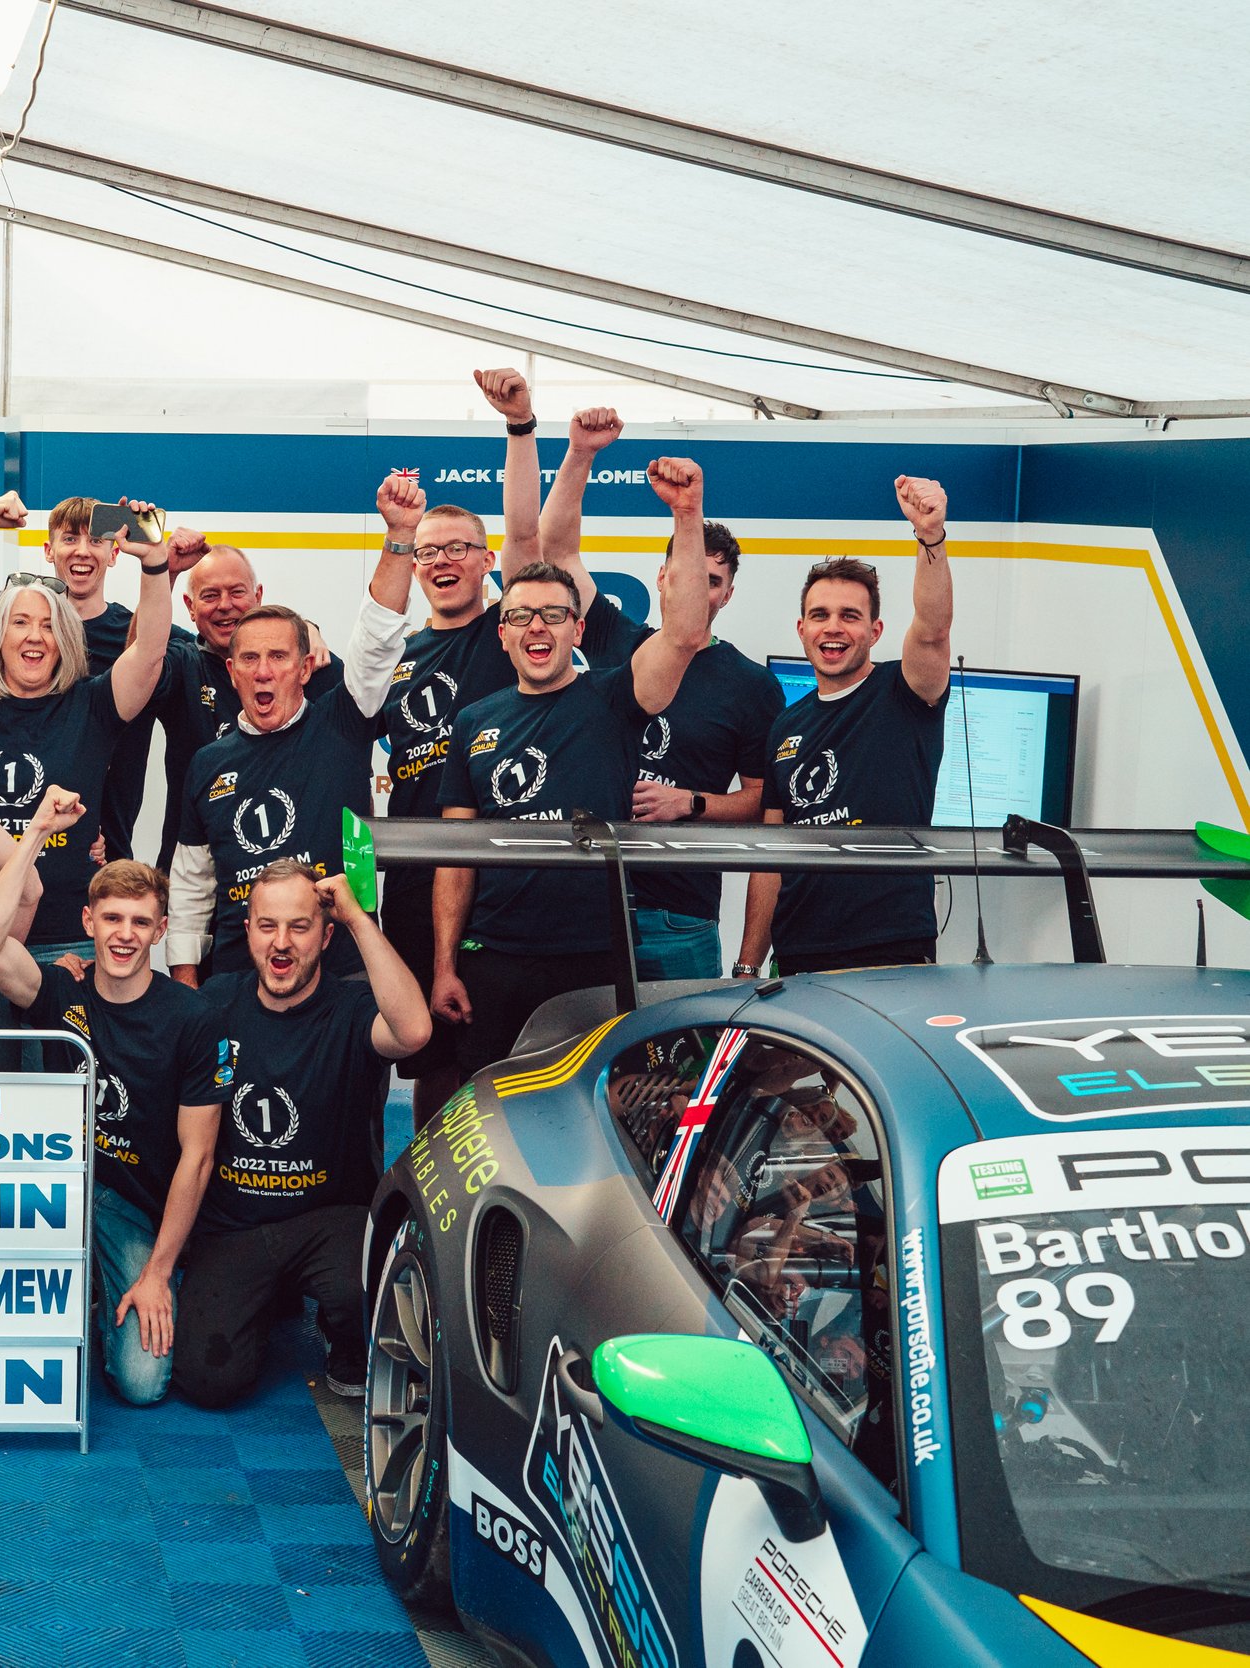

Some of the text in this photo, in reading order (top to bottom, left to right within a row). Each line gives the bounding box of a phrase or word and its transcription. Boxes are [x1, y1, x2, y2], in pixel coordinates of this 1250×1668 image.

[434, 469, 491, 483] JACK
[421, 685, 437, 718] 1
[4, 761, 17, 793] 1
[510, 762, 526, 787] 1
[254, 803, 270, 838] 1
[257, 1098, 272, 1133] 1
[219, 1165, 327, 1190] CHAMPIONS
[231, 1156, 314, 1172] 2022 TEAM
[971, 1161, 1023, 1177] TESTING
[238, 1187, 259, 1195] Porsche
[996, 1272, 1136, 1351] 89
[902, 1228, 941, 1466] www.porsche.co.uk
[476, 1501, 543, 1577] BOSS
[744, 1568, 776, 1612] CARRERA
[773, 1604, 791, 1629] CUP
[760, 1538, 847, 1645] PORSCHE
[737, 1585, 760, 1619] GREAT
[756, 1608, 785, 1652] BRITAIN
